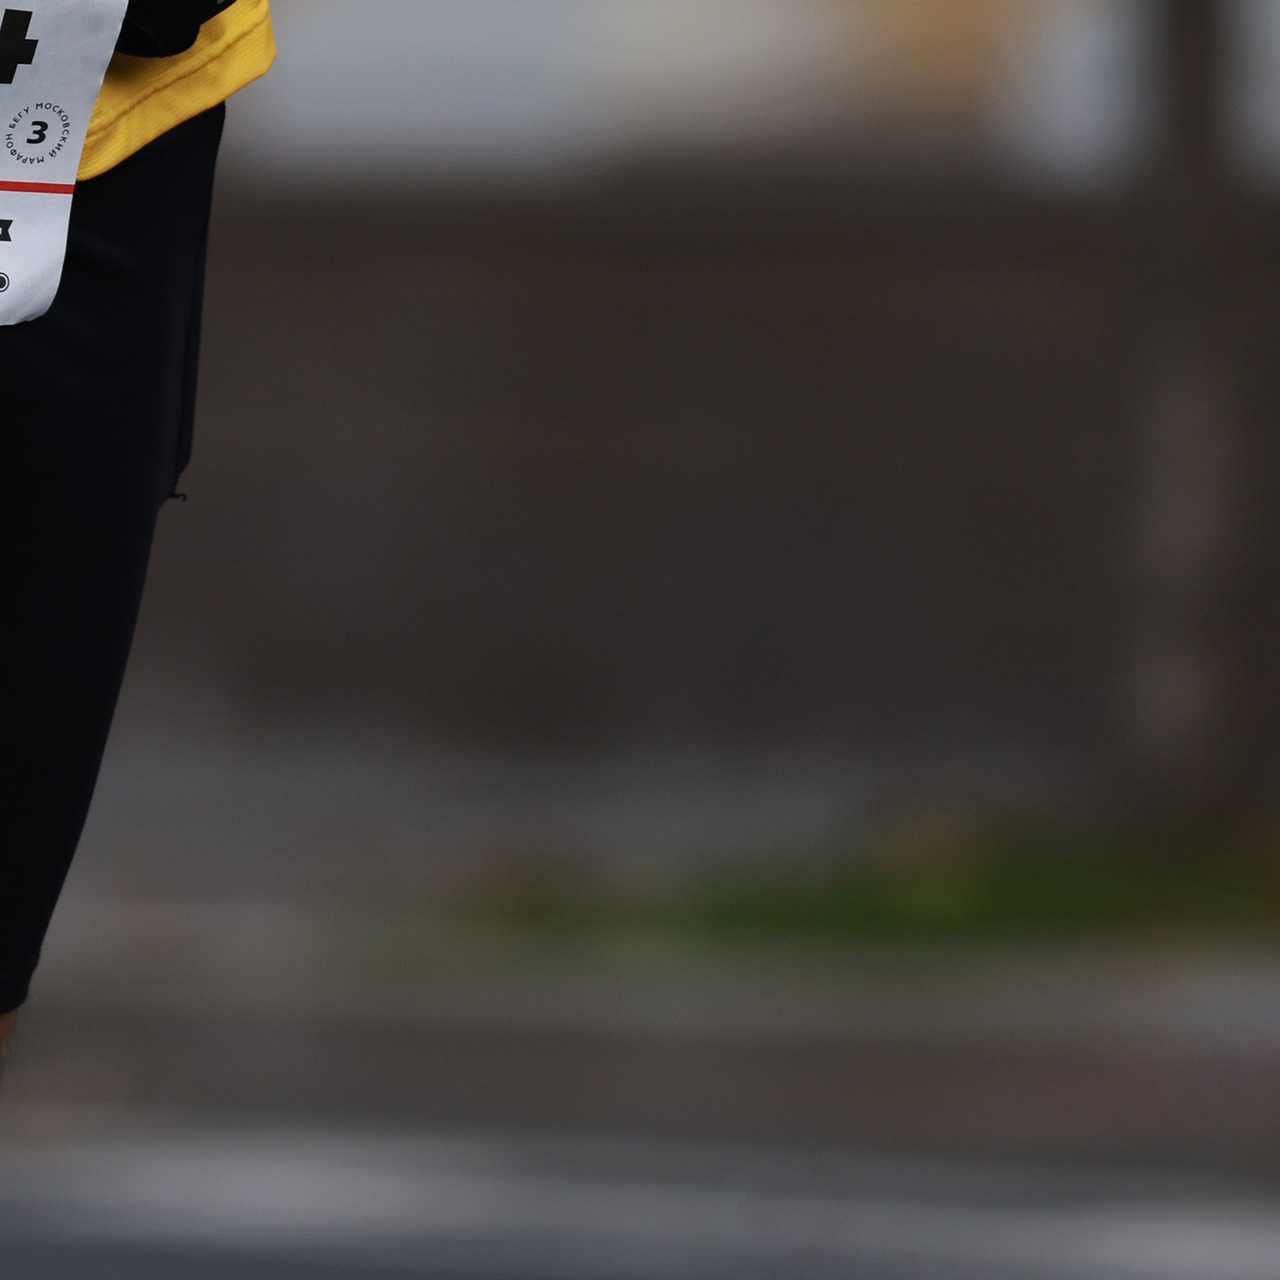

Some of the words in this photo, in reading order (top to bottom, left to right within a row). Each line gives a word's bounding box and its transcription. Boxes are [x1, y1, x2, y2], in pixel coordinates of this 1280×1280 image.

[26, 120, 49, 145] 3
[35, 102, 70, 158] МОСКОВСКИЙ
[5, 133, 45, 164] МАРАФОН
